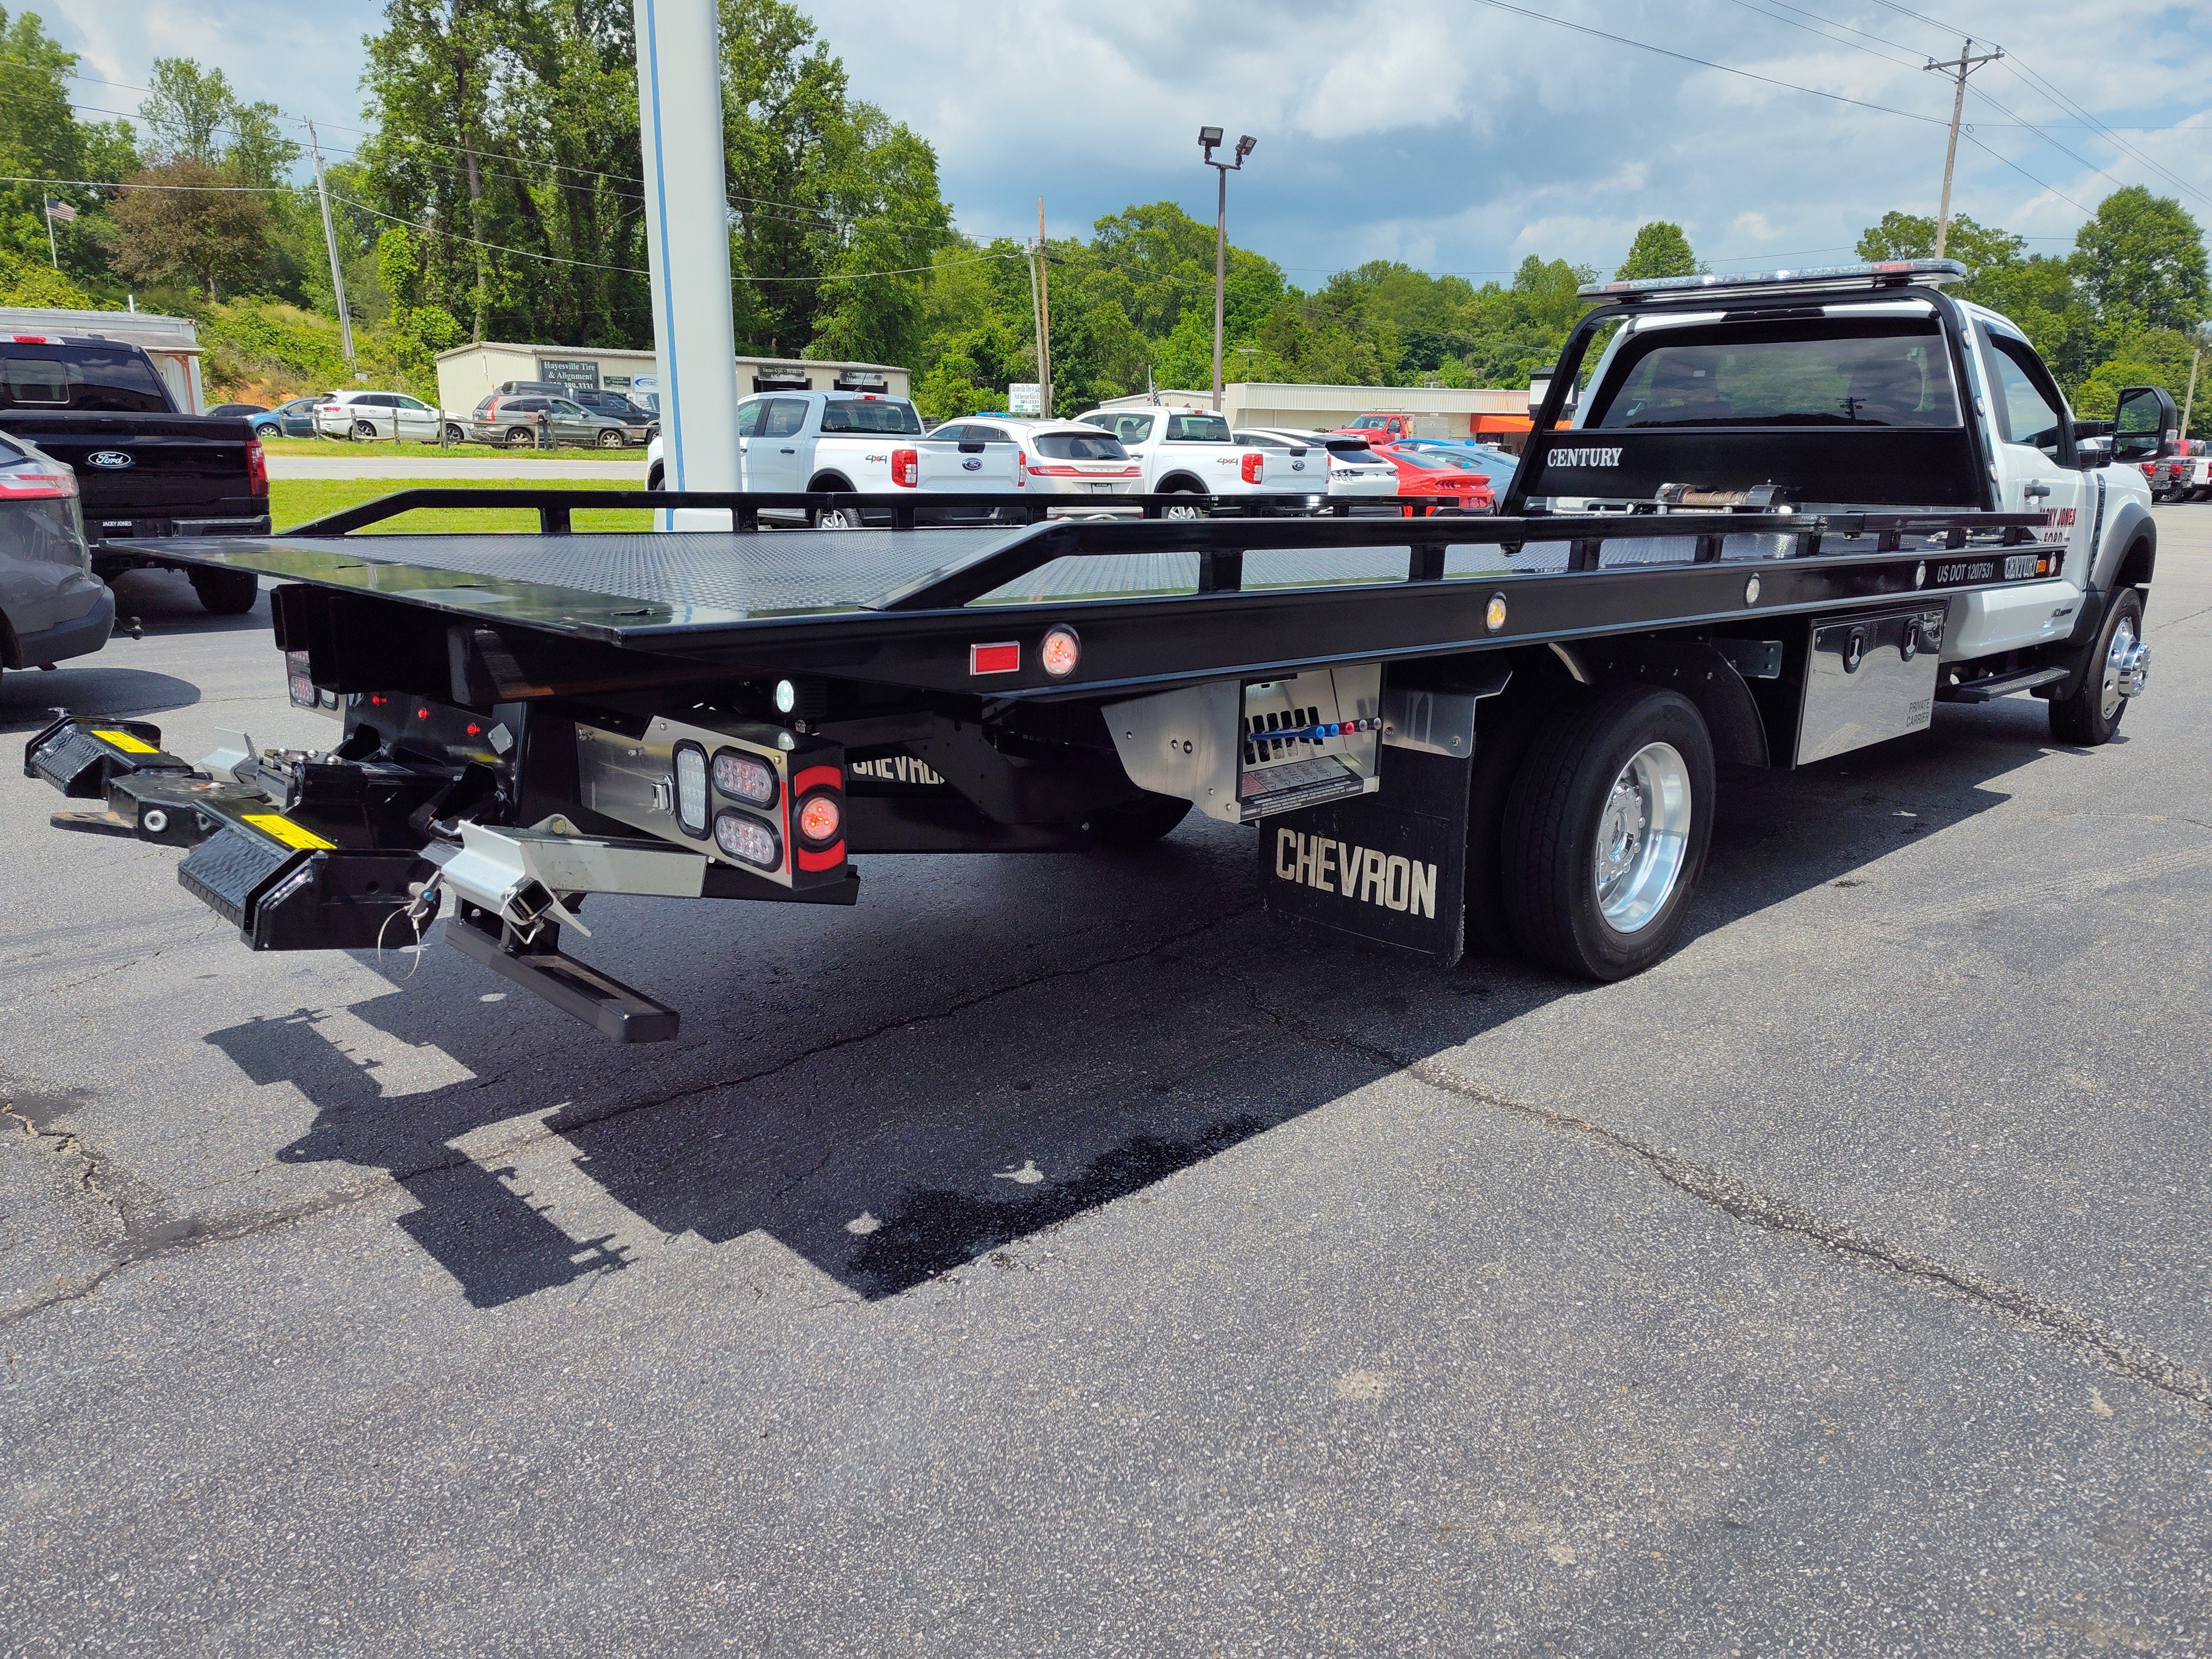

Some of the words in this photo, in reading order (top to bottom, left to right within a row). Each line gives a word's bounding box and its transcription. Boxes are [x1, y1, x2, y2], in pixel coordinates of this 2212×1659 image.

[544, 361, 579, 371] Hayesville
[581, 363, 596, 371] Tire
[557, 372, 592, 381] Alignment
[96, 453, 124, 464] Ford
[1547, 448, 1623, 467] CENTURY
[1937, 565, 1949, 583] US
[1949, 563, 1967, 582] DOT
[1967, 562, 1994, 580] 1207531
[1909, 698, 1930, 713] PRIVATE
[1906, 711, 1928, 727] CARRIER
[1276, 827, 1437, 919] CHEVRON
